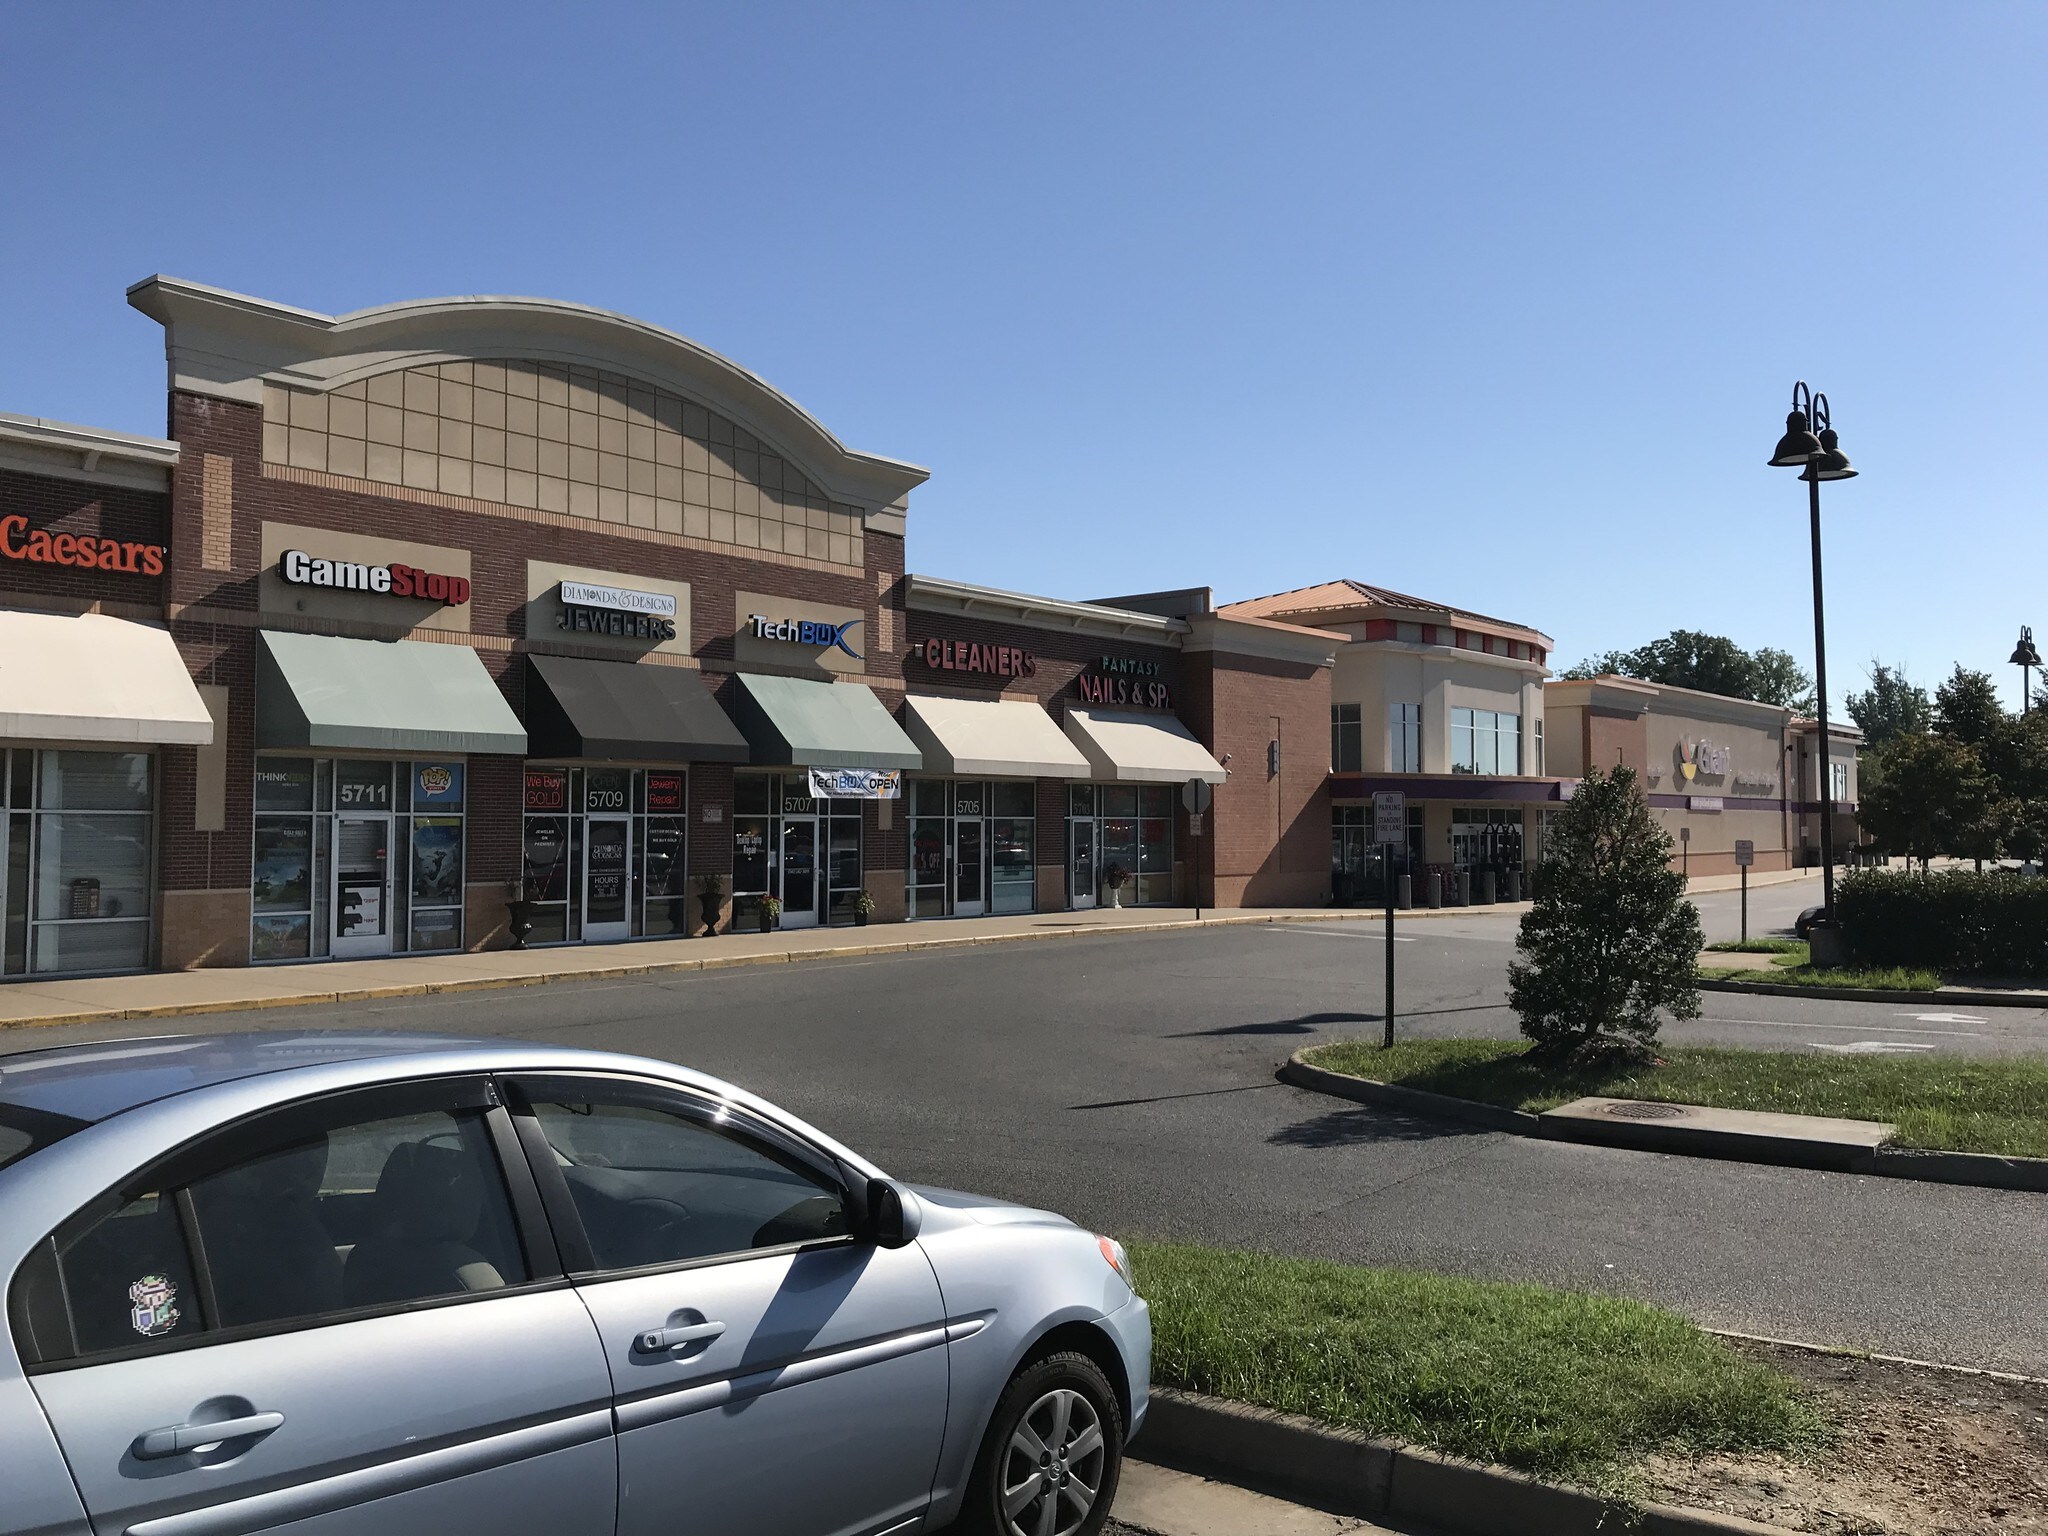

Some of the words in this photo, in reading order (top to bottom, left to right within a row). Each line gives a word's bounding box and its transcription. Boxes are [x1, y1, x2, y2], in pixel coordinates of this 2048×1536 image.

[0, 514, 164, 576] Caesars
[282, 549, 470, 607] GameStop
[562, 584, 617, 605] DIAMONDS
[618, 590, 631, 608] &
[631, 594, 675, 613] DESIGNS
[561, 607, 676, 641] JEWELERS
[751, 613, 866, 661] TechBOX
[925, 637, 1036, 678] CLEANERS
[1102, 655, 1160, 677] FANTASY
[1079, 674, 1127, 705] NAILS
[1131, 682, 1144, 705] &
[420, 767, 452, 787] POP!
[527, 775, 542, 788] We
[543, 775, 561, 791] Buy
[812, 771, 878, 796] TechBOX
[869, 778, 899, 790] OPEN
[340, 784, 386, 803] 5711
[526, 791, 561, 806] GOLD
[588, 790, 624, 808] 5709
[1385, 795, 1394, 803] NO
[784, 797, 812, 812] 5707
[957, 800, 980, 814] 5705
[1377, 824, 1389, 832] FIRE
[594, 876, 619, 884] HOURS
